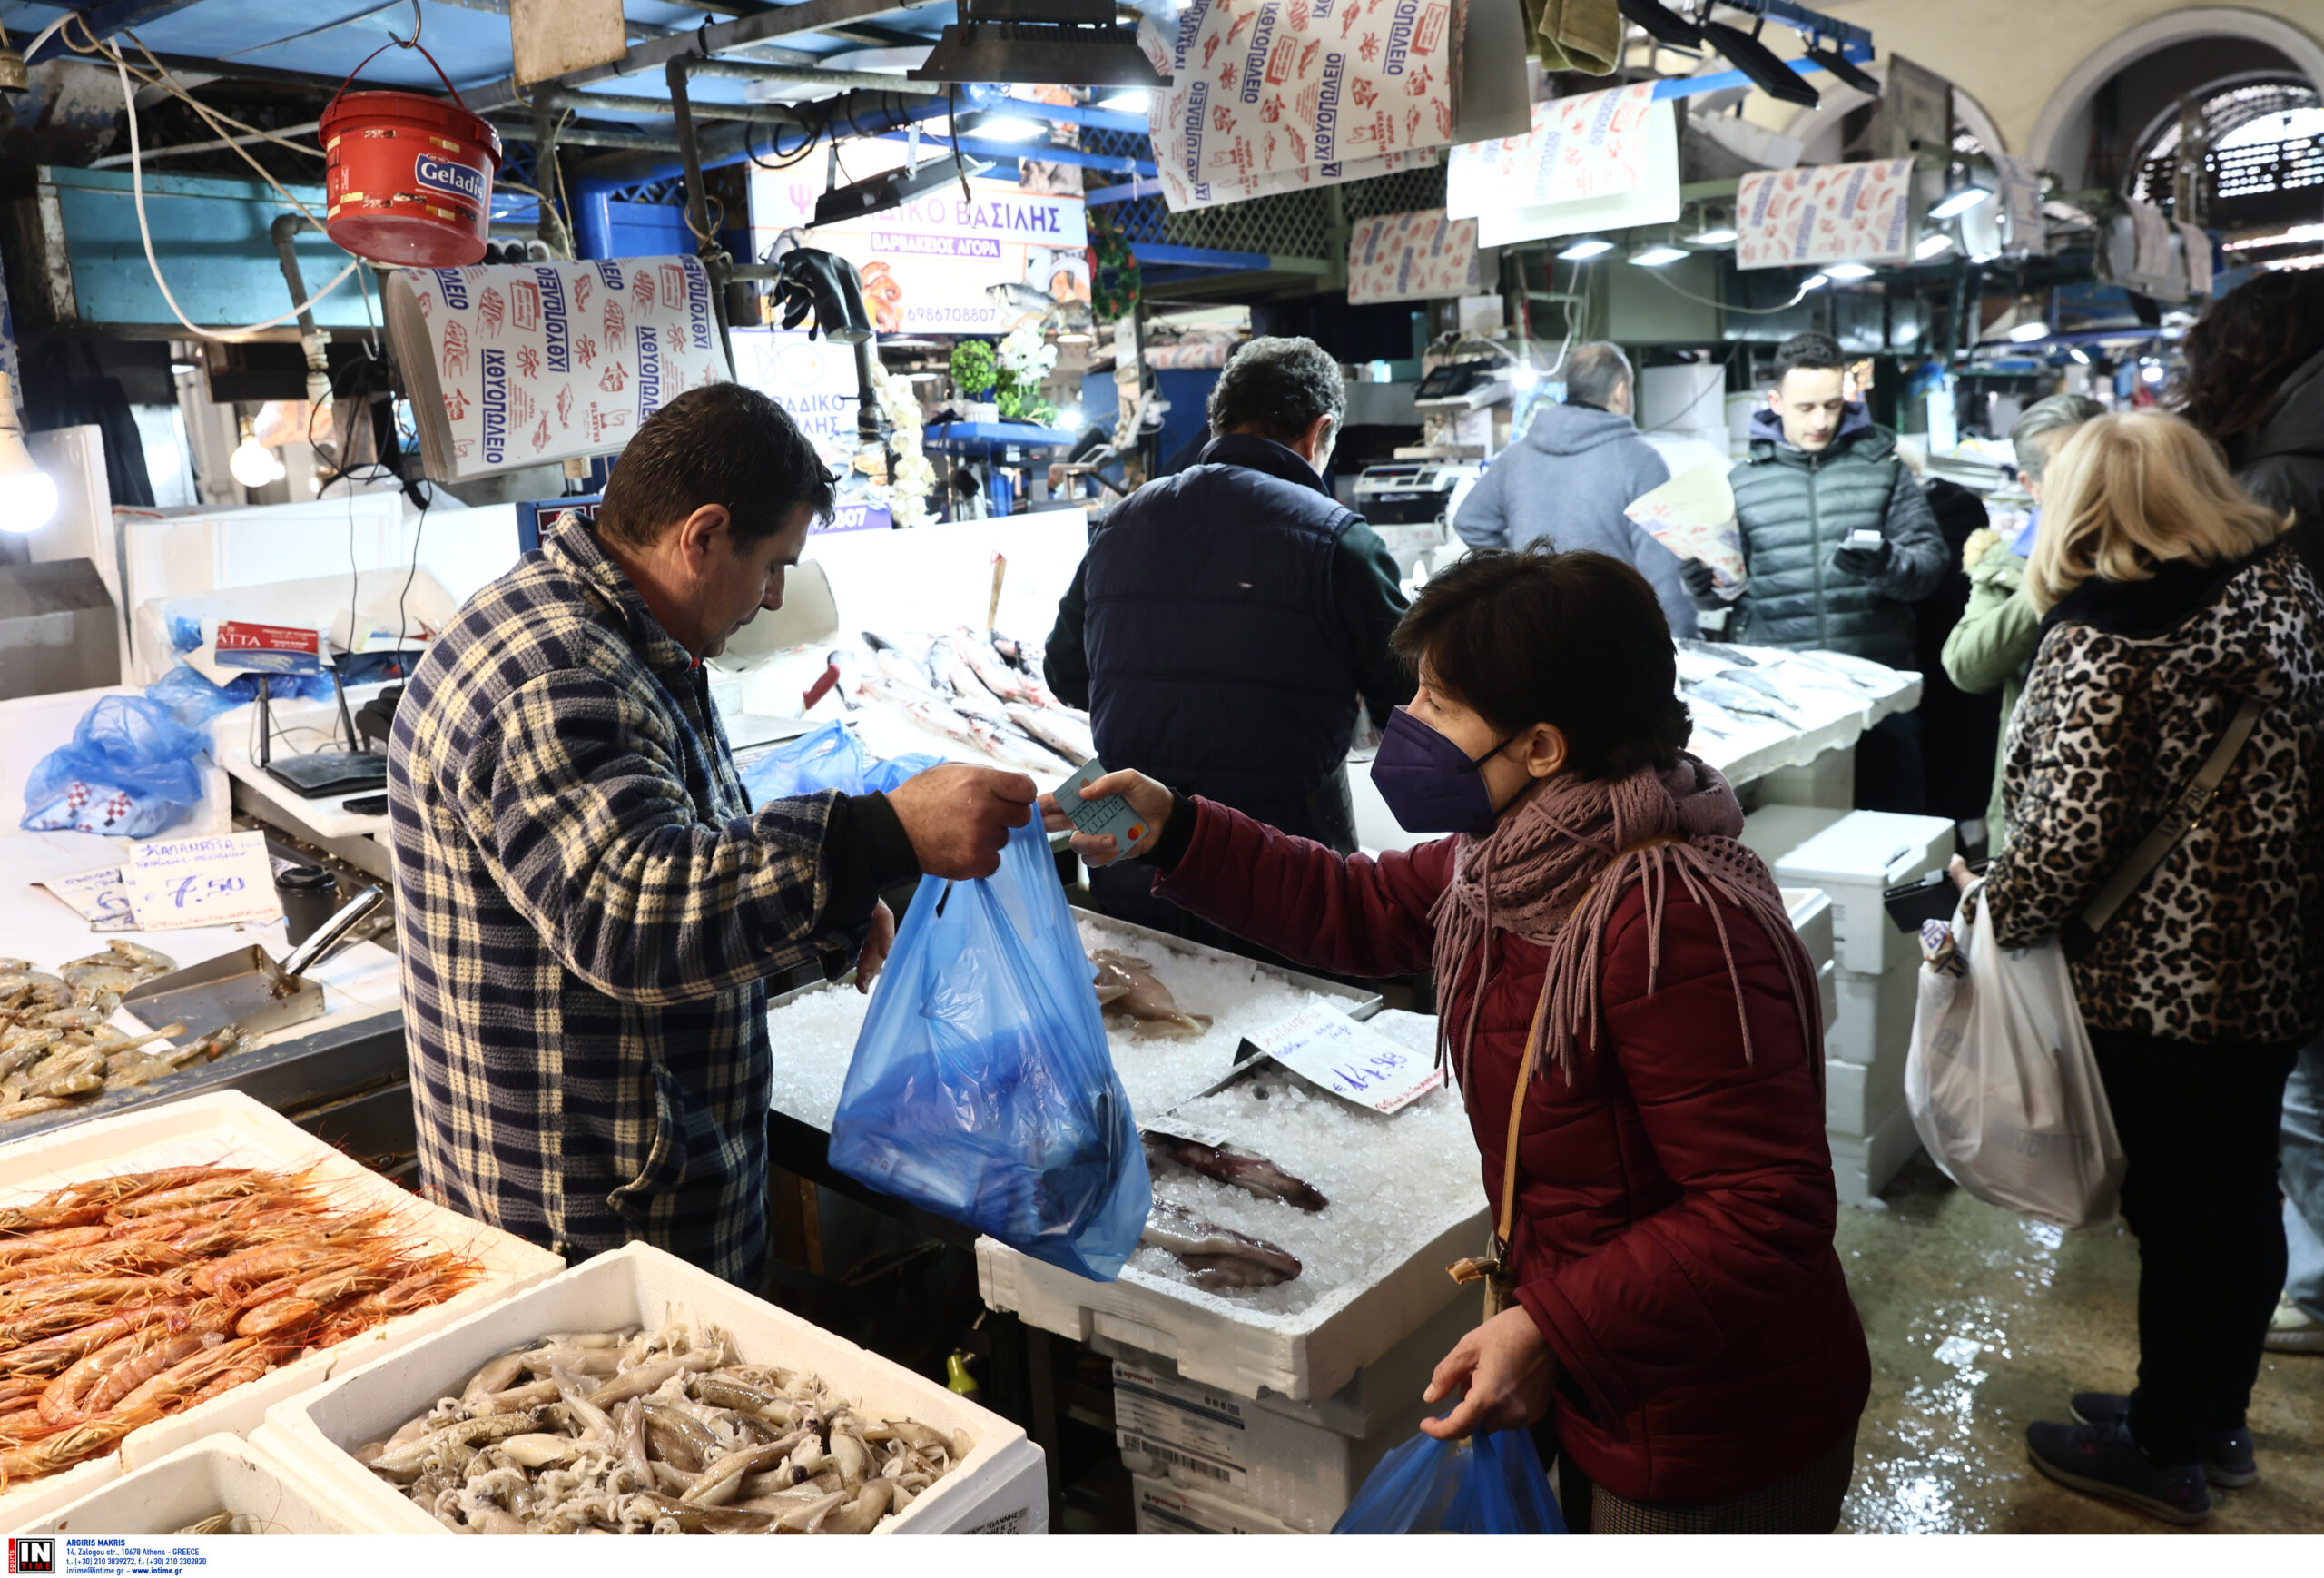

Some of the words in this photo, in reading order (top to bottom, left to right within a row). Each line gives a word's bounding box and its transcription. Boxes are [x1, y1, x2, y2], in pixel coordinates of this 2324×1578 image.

[1244, 2, 1281, 104] ΙΧΘΥΟΠΩΛΕΙΟ
[1315, 53, 1341, 161] ΙΧΘΥΟΠΩΛΕΙΟ
[420, 161, 484, 200] Geladis
[956, 199, 1061, 232] ΒΑΣΙΛΗΣ
[872, 233, 955, 255] ΒΑΡΒΑΚΕΙΟΣ
[957, 239, 999, 257] ΑΓΟΡΑ
[534, 268, 567, 373] ΙΧΘΥΟΠΩΛΕΙΟ
[907, 306, 997, 322] 6986708807
[485, 349, 507, 464] ΙΧΘΥΟΠΩΛΕΙΟ
